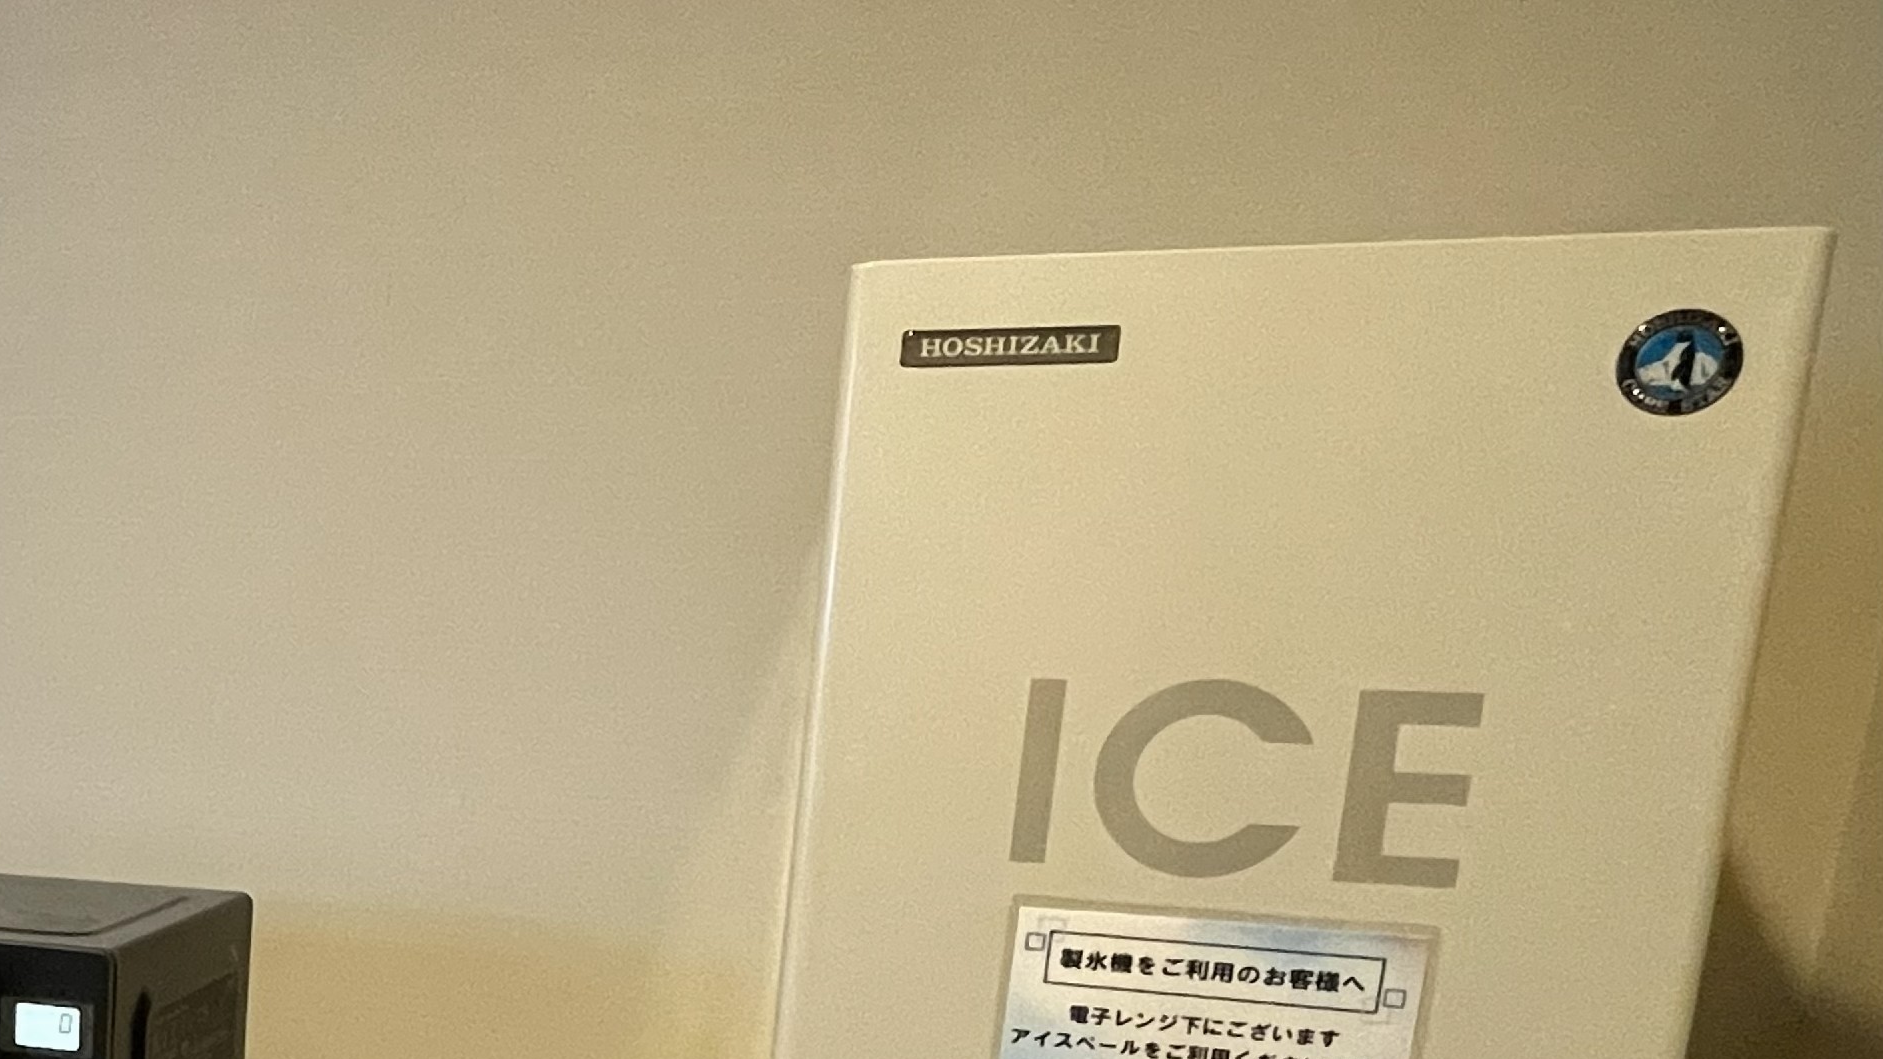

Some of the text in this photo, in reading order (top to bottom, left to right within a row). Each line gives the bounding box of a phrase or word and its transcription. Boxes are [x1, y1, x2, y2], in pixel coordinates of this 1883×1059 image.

[920, 333, 1102, 357] HOSHIZAKI
[1009, 678, 1485, 889] ICE
[1059, 946, 1366, 994] 製氷機をご利用のお客様へ
[58, 1012, 73, 1034] 0
[1069, 1004, 1341, 1048] 電子レンジ下にございます
